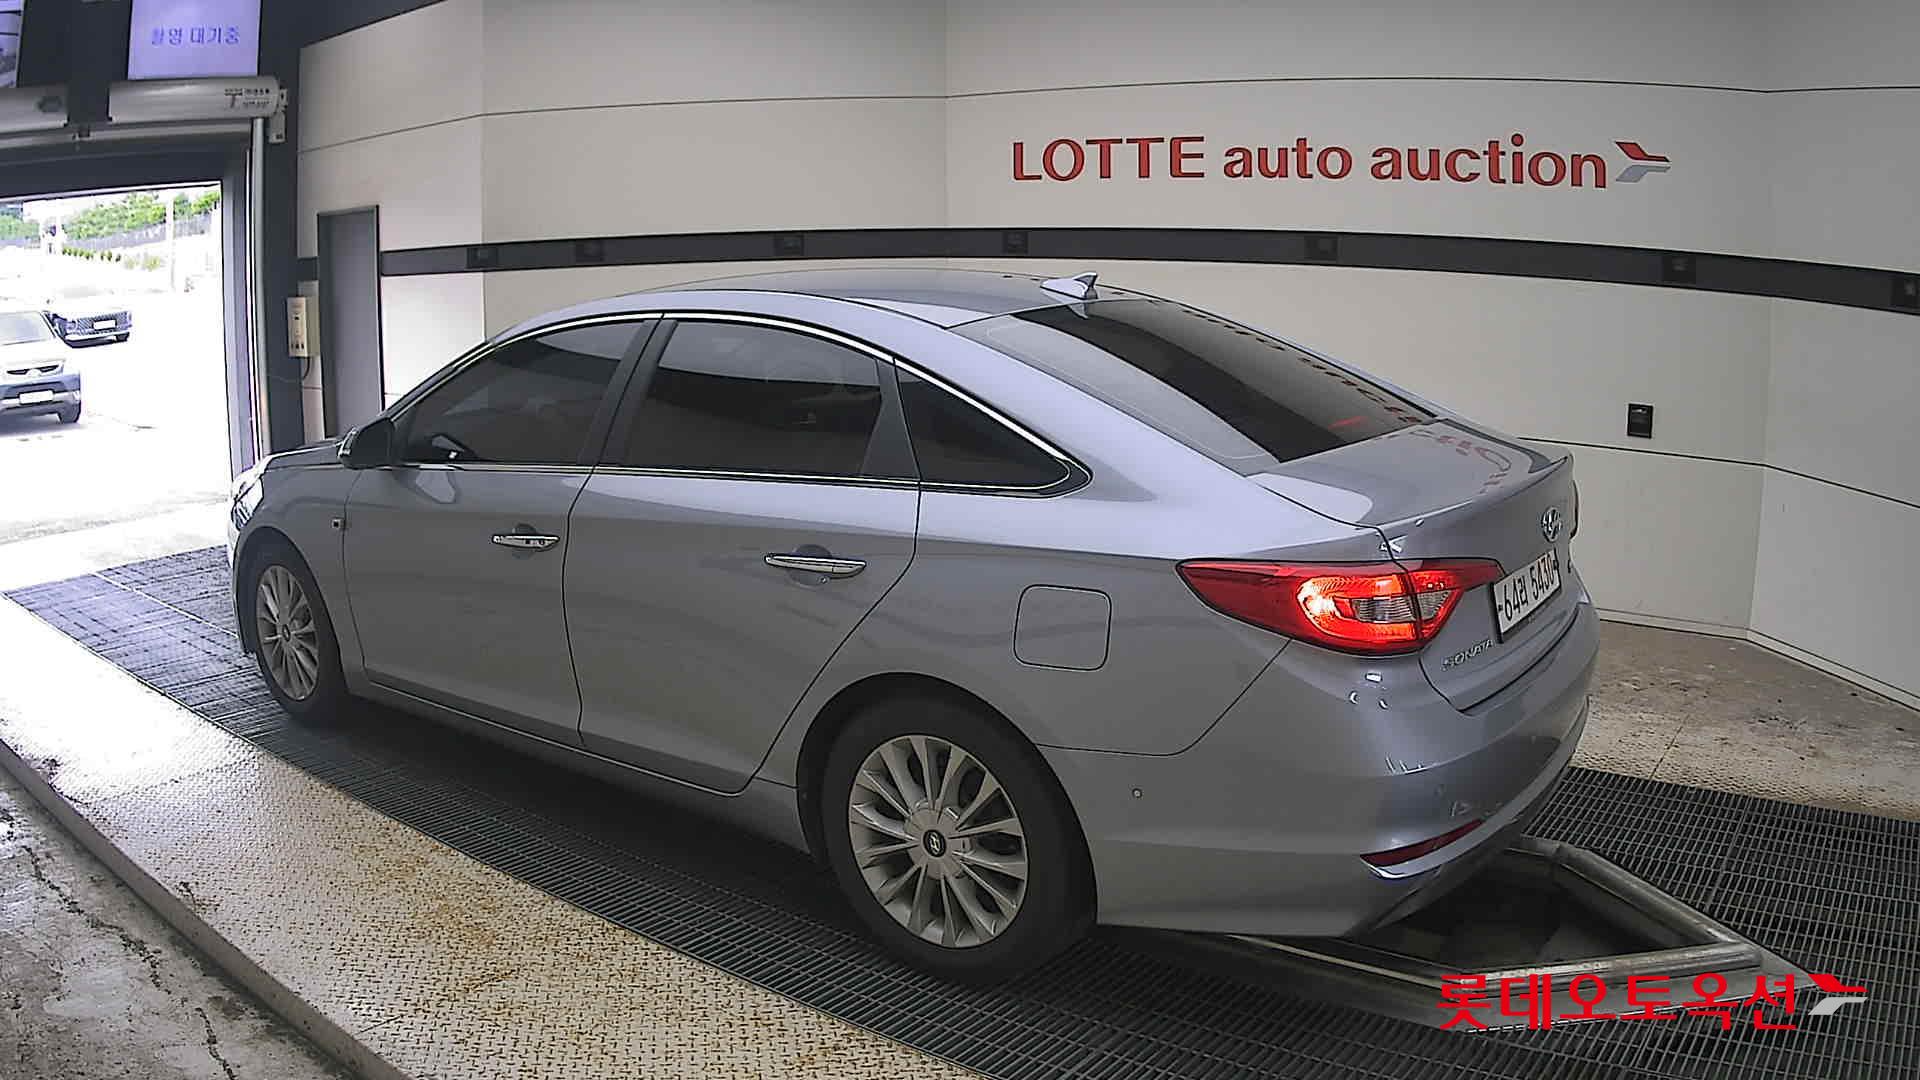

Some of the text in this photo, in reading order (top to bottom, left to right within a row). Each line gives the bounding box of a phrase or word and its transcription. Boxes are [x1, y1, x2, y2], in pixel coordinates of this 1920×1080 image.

[191, 27, 240, 45] 대기중
[1012, 133, 1606, 188] LOTTE auto auction
[1530, 554, 1555, 600] 5430
[1441, 639, 1493, 672] SONATA
